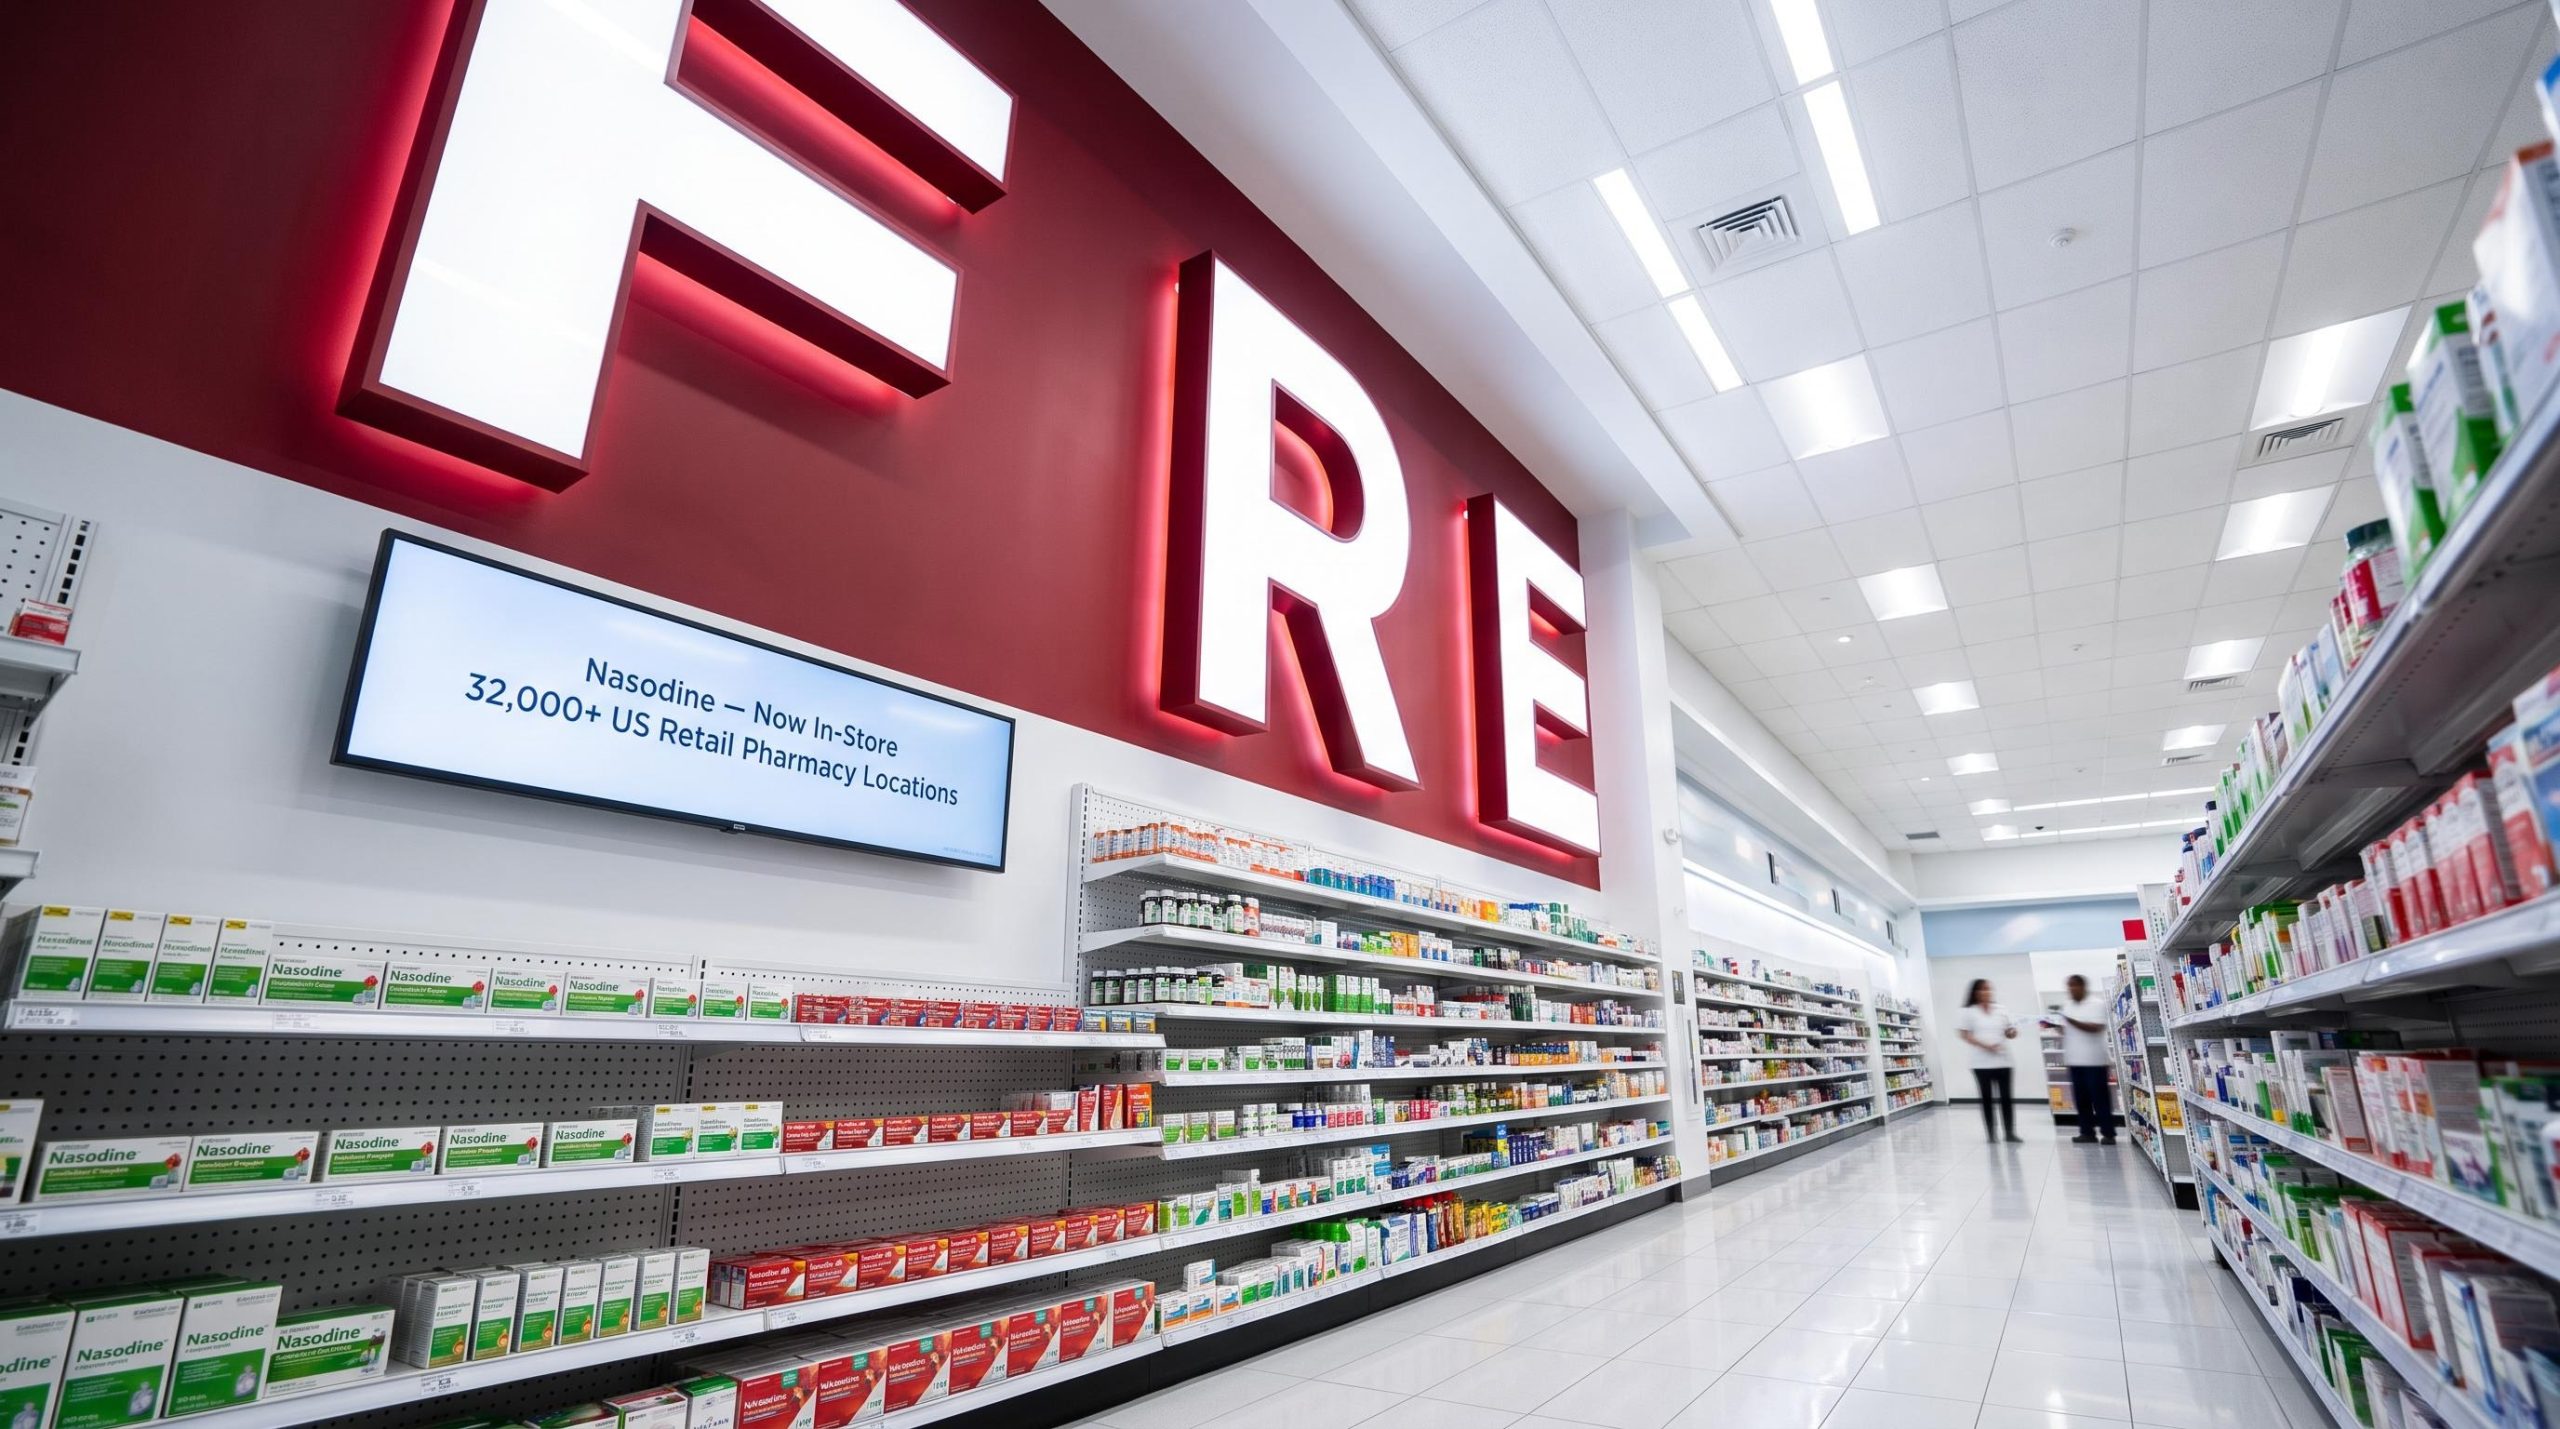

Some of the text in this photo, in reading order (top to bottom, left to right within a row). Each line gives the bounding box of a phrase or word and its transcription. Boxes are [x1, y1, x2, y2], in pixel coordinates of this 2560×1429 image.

[586, 658, 714, 713] Nasodine
[754, 701, 806, 735] Now
[814, 717, 897, 758] In-Store
[465, 673, 958, 806] 32,000+ US Retail Pharmacy Locations
[271, 963, 342, 979] Nasodine
[390, 970, 451, 984] Nasodine
[494, 976, 546, 988] Nasodine
[569, 980, 619, 992] Nasodine
[449, 1132, 507, 1145] Nasodine
[555, 1128, 606, 1140] Nasodine
[196, 1143, 272, 1157] Nasodine
[334, 1137, 400, 1150] Nasodine
[49, 1149, 137, 1165] Nasodine
[186, 1324, 265, 1347] Nasodine
[276, 1327, 361, 1350] Nasodine
[76, 1339, 164, 1363] Nasodine
